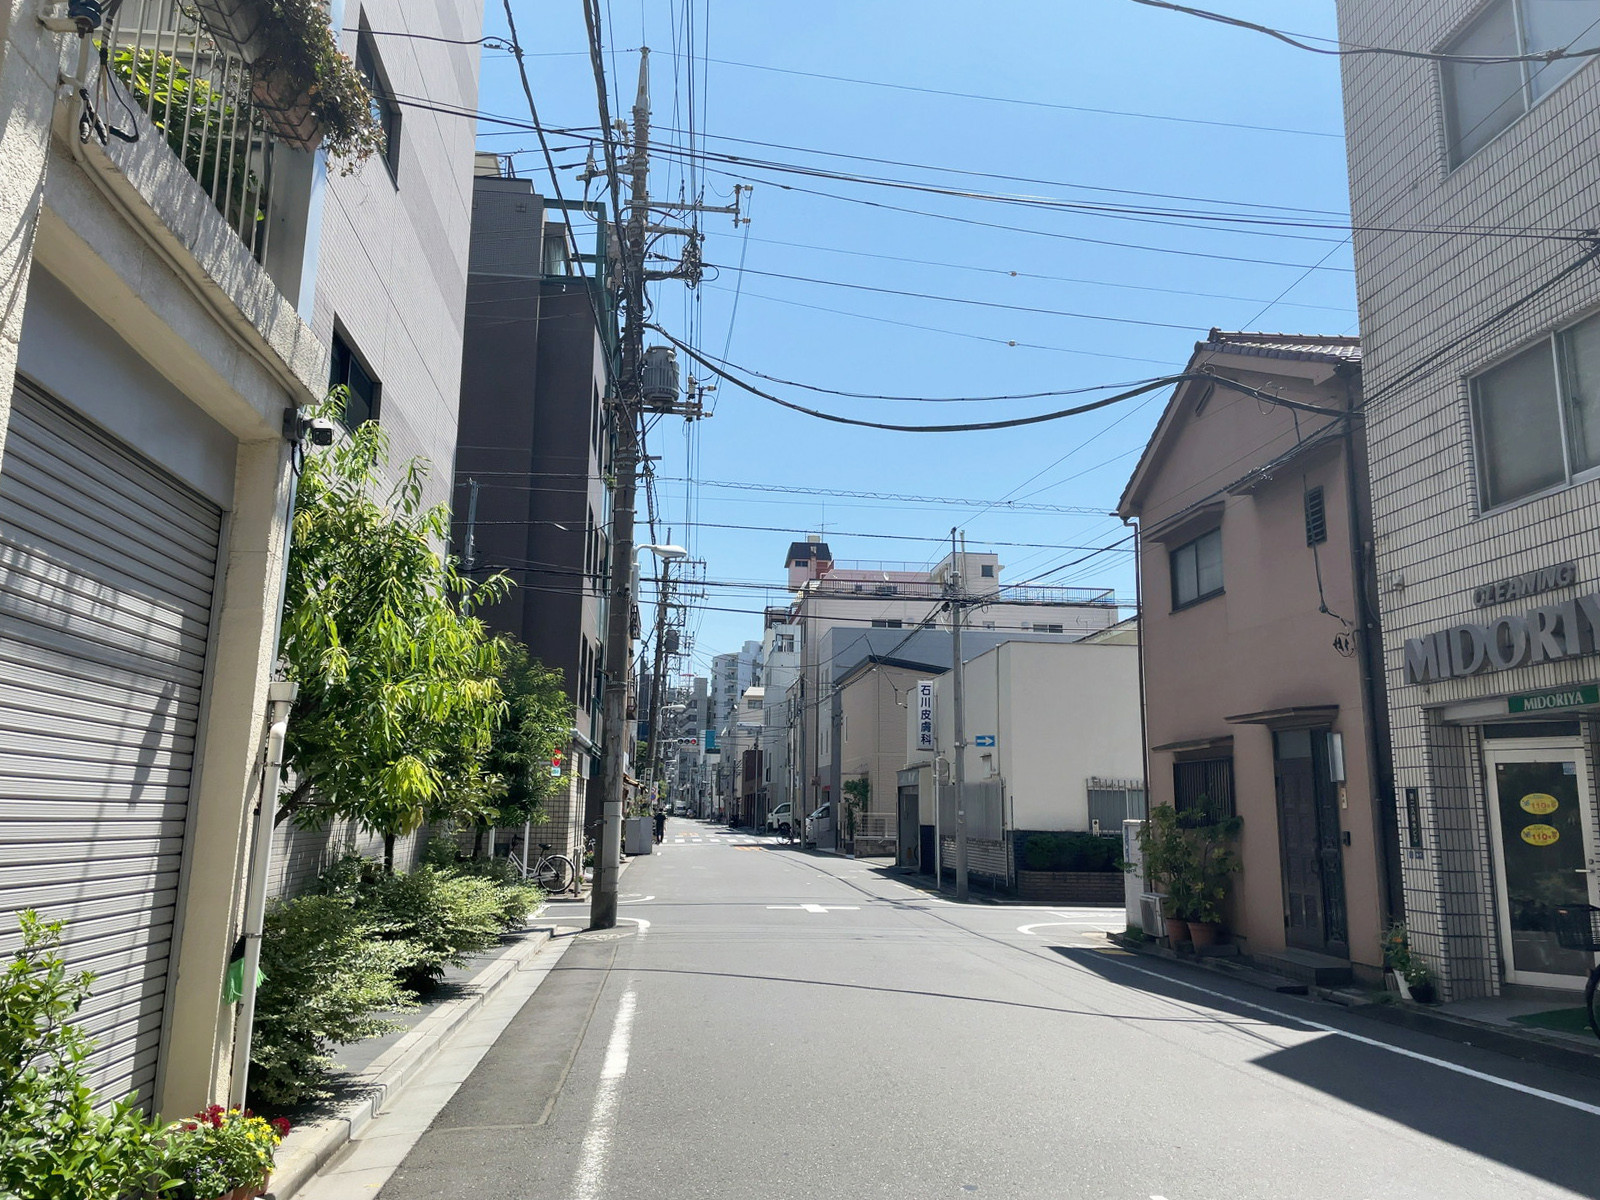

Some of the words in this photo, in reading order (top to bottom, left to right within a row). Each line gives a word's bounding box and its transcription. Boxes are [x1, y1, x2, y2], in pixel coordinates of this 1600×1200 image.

[1473, 562, 1576, 608] CLEANING
[920, 684, 931, 745] 石川皮膚科
[1523, 691, 1584, 710] MIDORIYA
